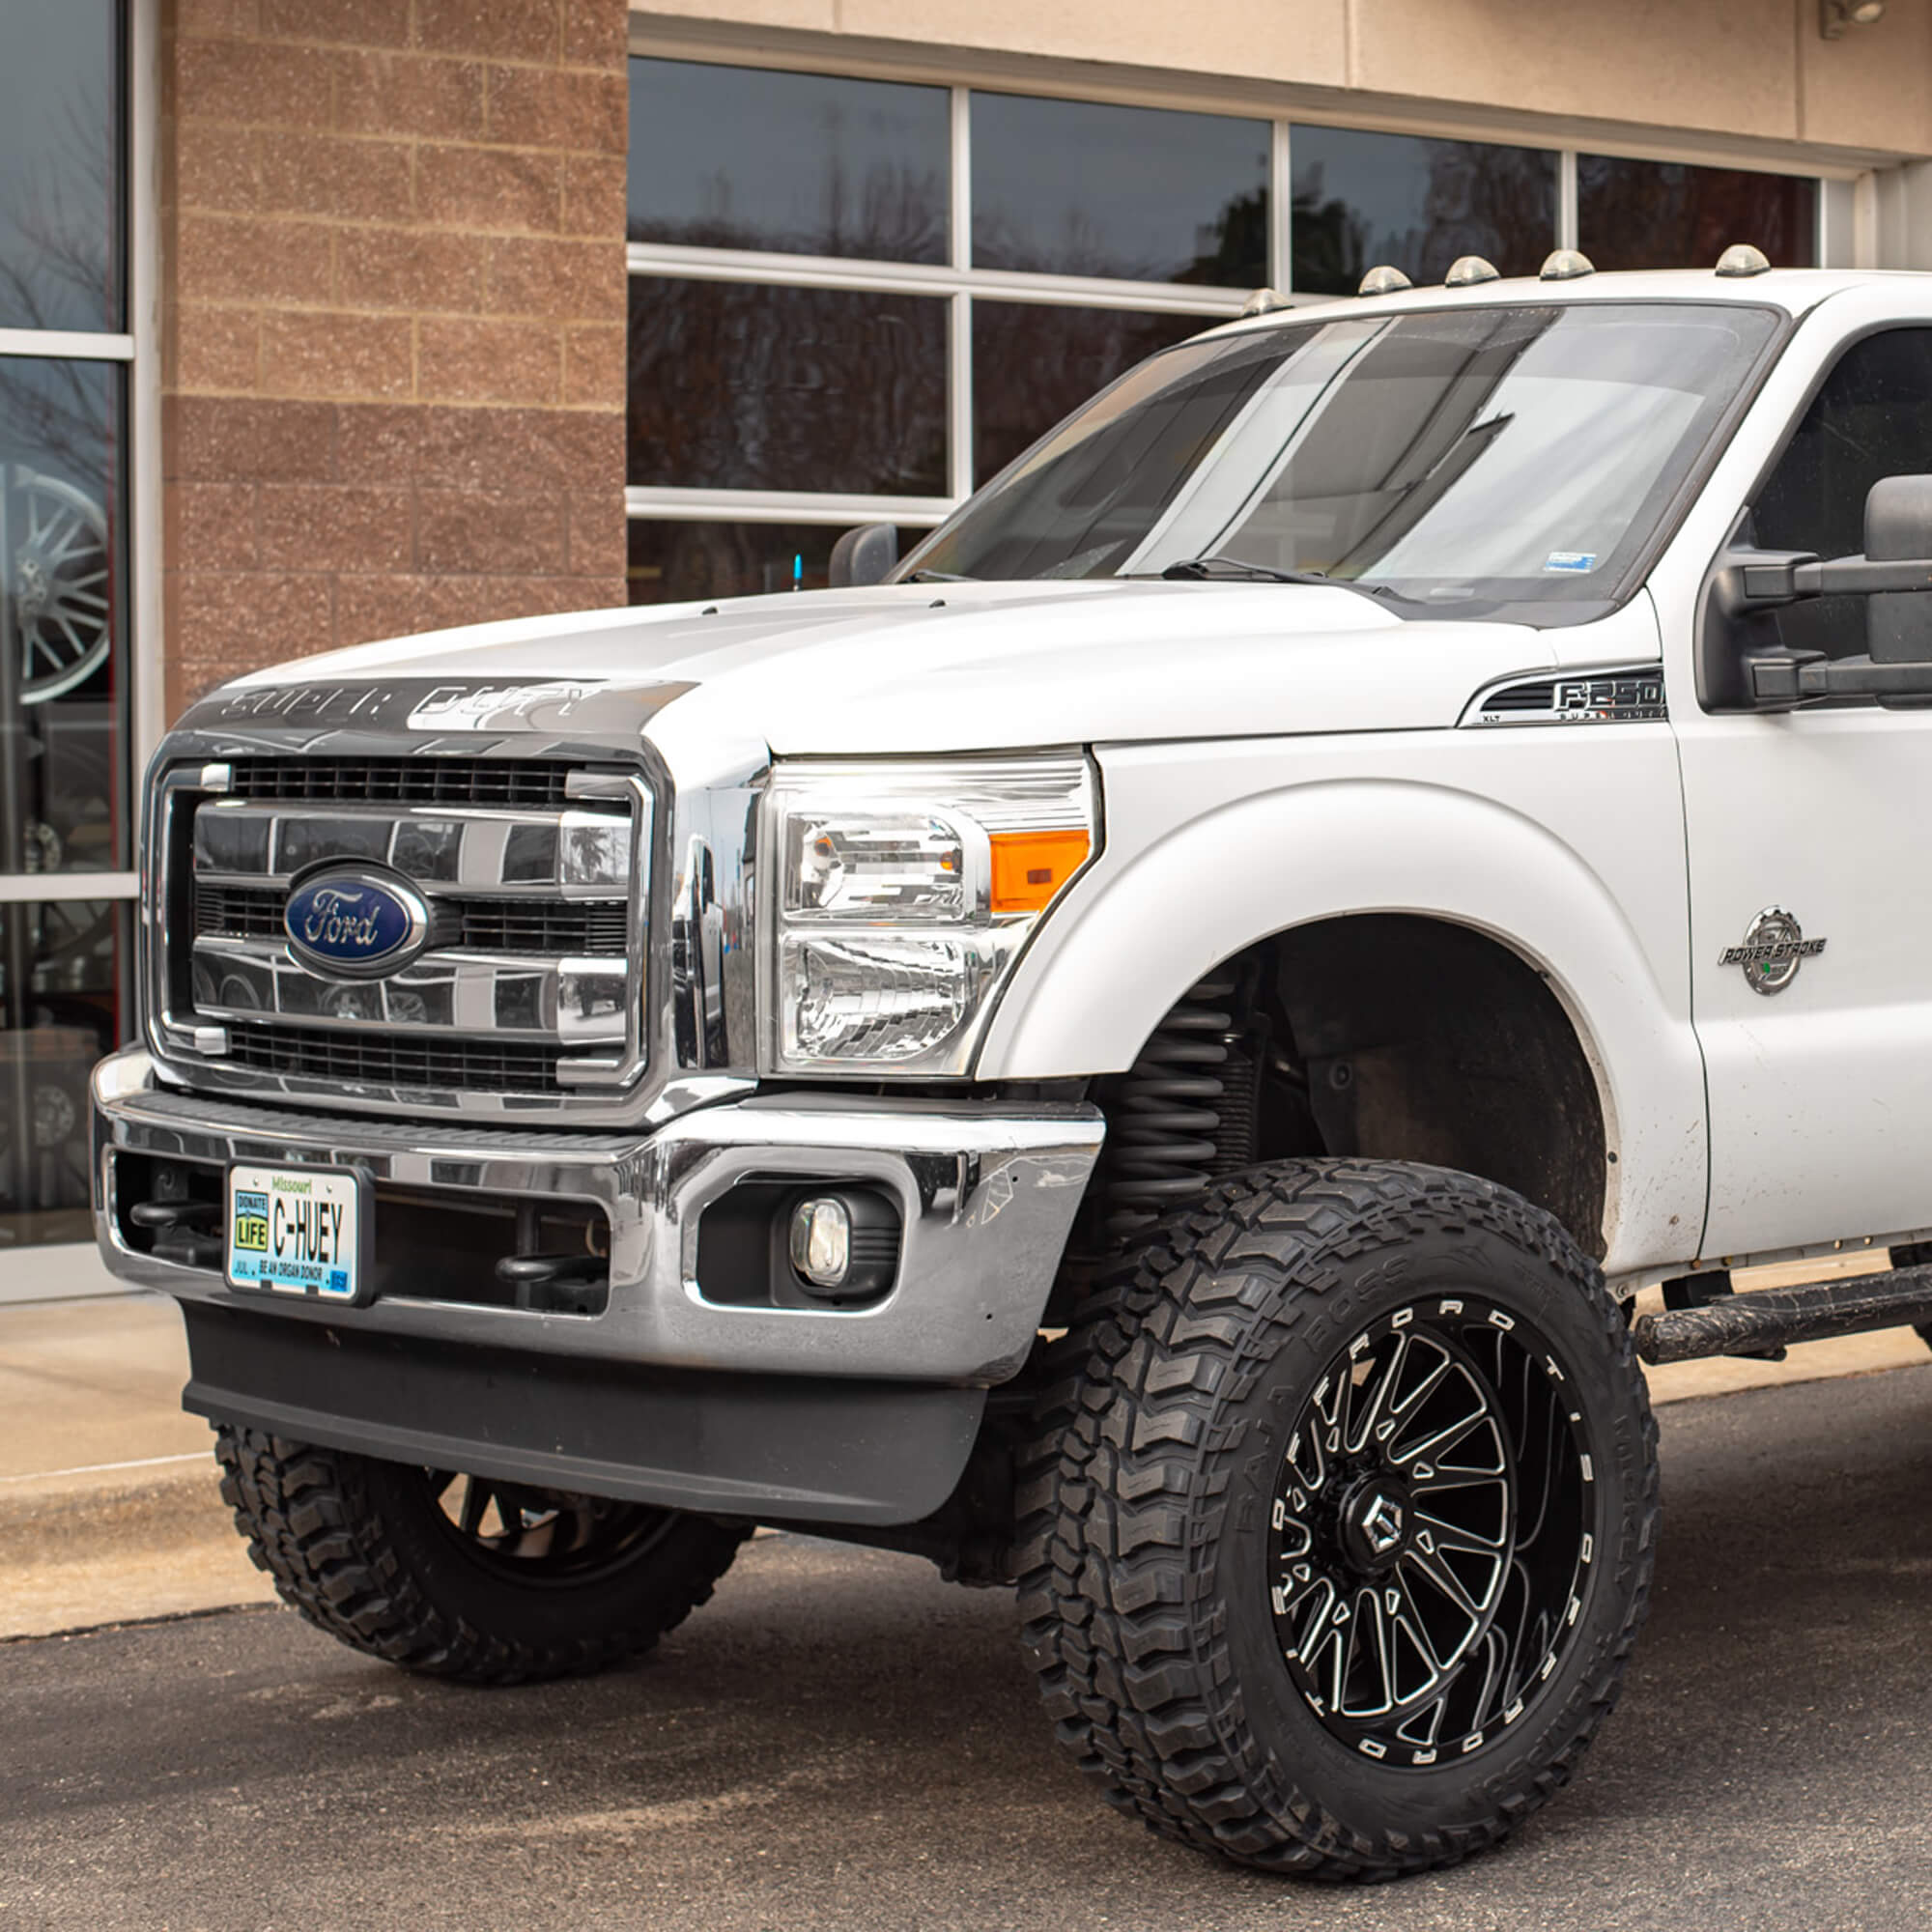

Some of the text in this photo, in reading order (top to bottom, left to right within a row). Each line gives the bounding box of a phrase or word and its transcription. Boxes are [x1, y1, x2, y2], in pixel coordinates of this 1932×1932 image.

[304, 889, 381, 946] Ford
[1723, 938, 1828, 962] POWER STROKE
[271, 1176, 312, 1195] Missouri
[238, 1195, 267, 1210] DONATE
[238, 1221, 266, 1246] LIFE
[273, 1197, 343, 1265] C-HUEY
[259, 1260, 324, 1281] BE AN ORGAN DONOR
[1302, 1254, 1409, 1353] BOSS
